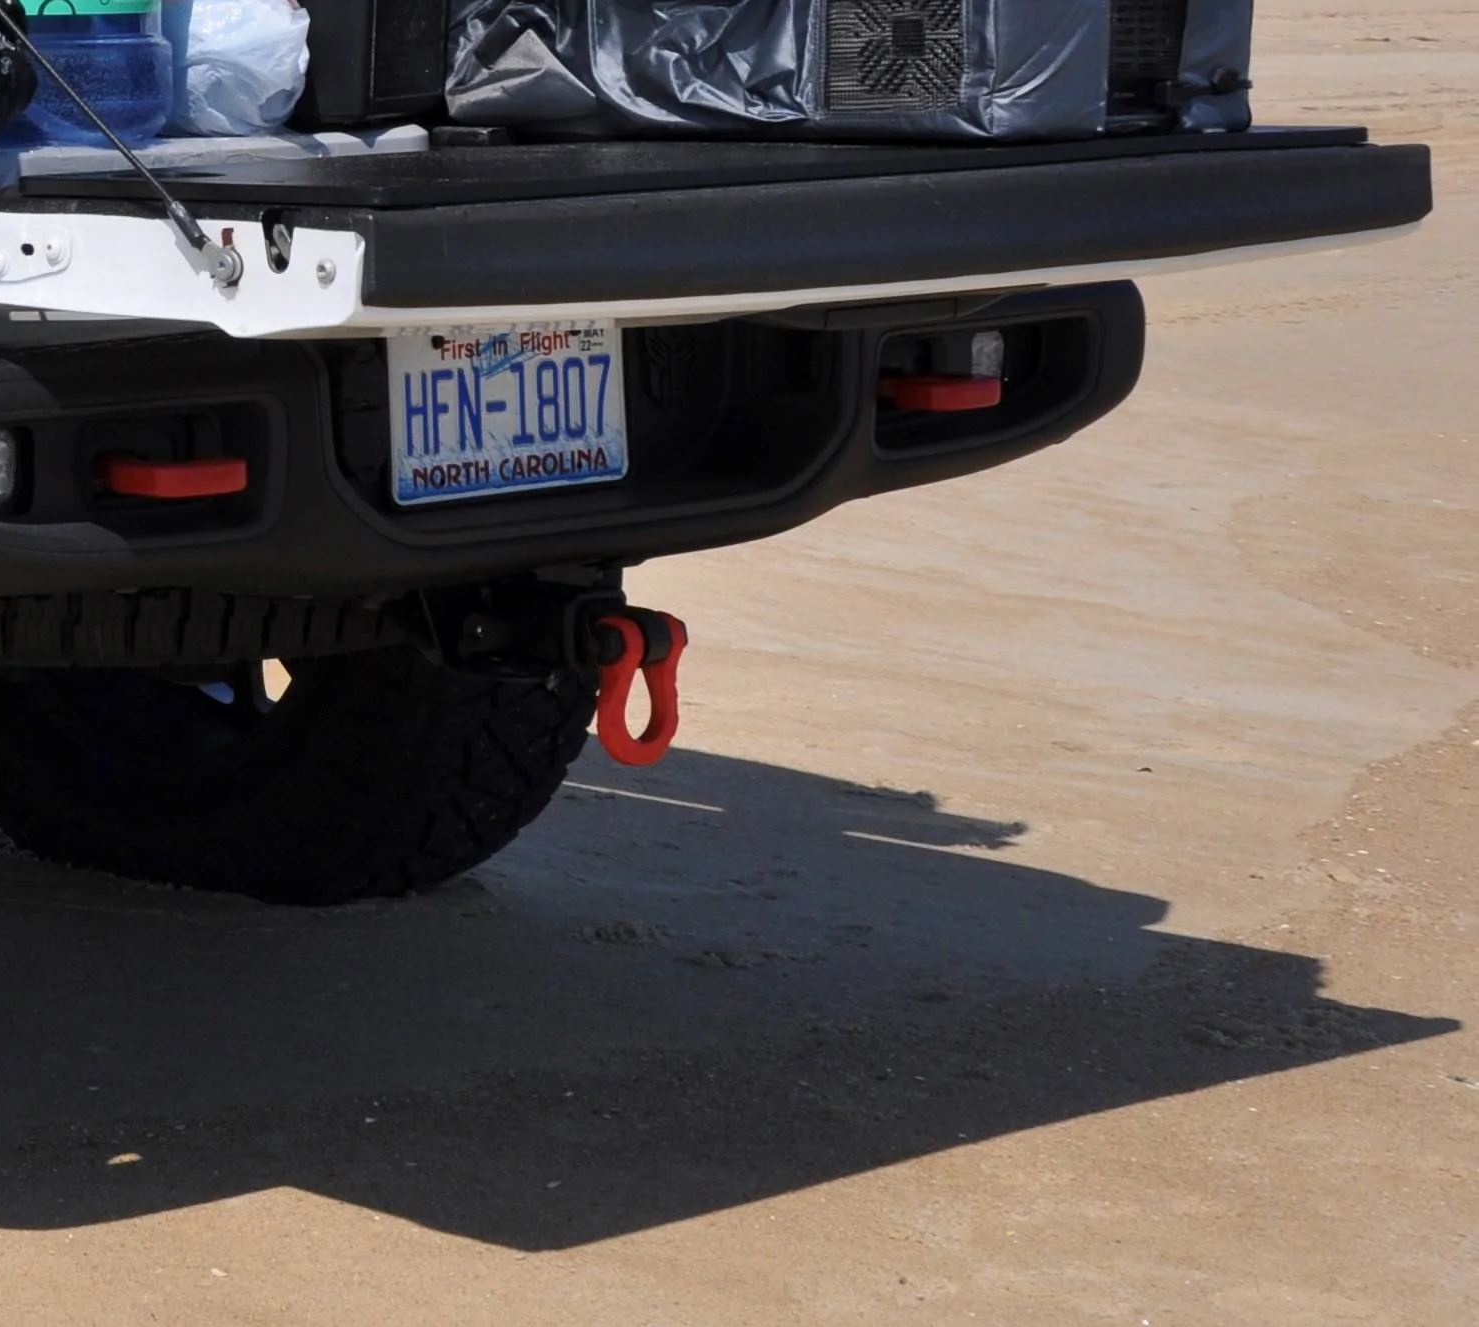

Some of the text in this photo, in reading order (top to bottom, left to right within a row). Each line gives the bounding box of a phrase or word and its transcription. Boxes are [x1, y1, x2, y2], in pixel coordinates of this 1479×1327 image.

[440, 336, 482, 361] First
[519, 330, 571, 356] Flight
[403, 354, 611, 458] HFN-1807
[412, 446, 609, 491] NORTH CAROLINA
